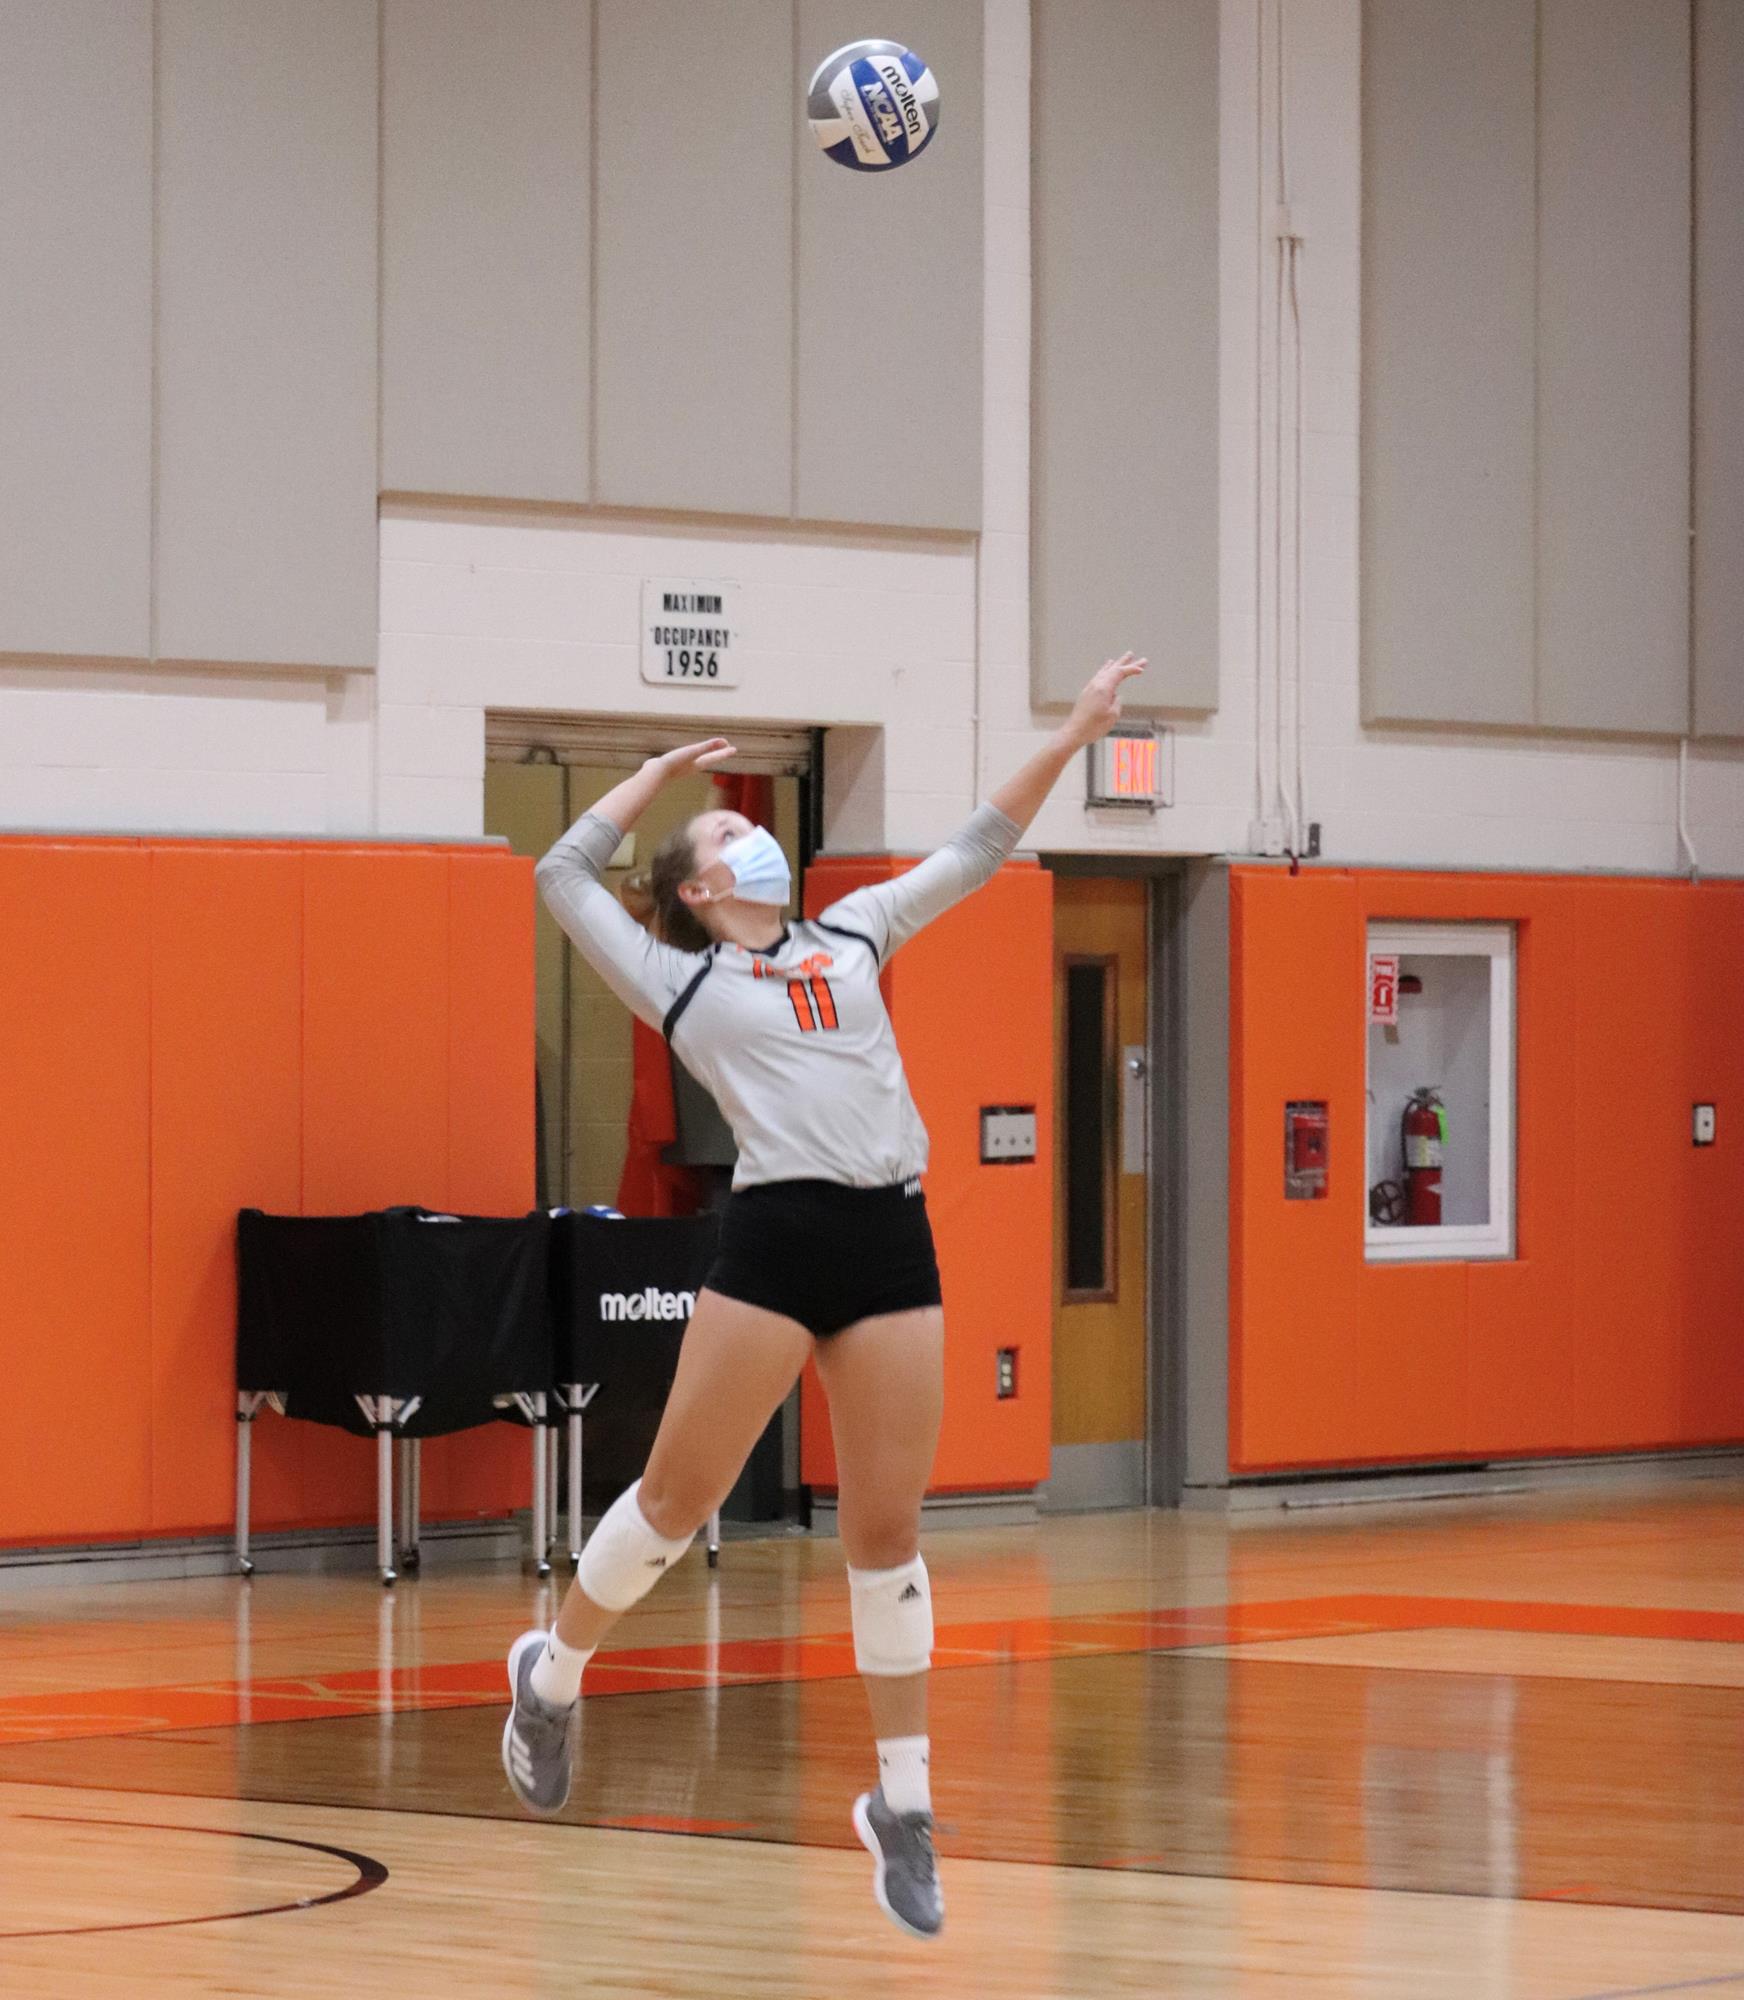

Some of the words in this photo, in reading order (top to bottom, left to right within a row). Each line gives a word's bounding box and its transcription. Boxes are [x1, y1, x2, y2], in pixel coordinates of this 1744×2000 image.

[860, 81, 903, 144] NCAA
[881, 66, 921, 135] molten
[663, 593, 722, 614] MAXIMUM
[654, 626, 729, 648] OCCUPANCY
[667, 650, 718, 677] 1956
[1113, 739, 1158, 793] EXIT
[787, 976, 839, 1032] 11
[600, 1287, 695, 1321] molten
